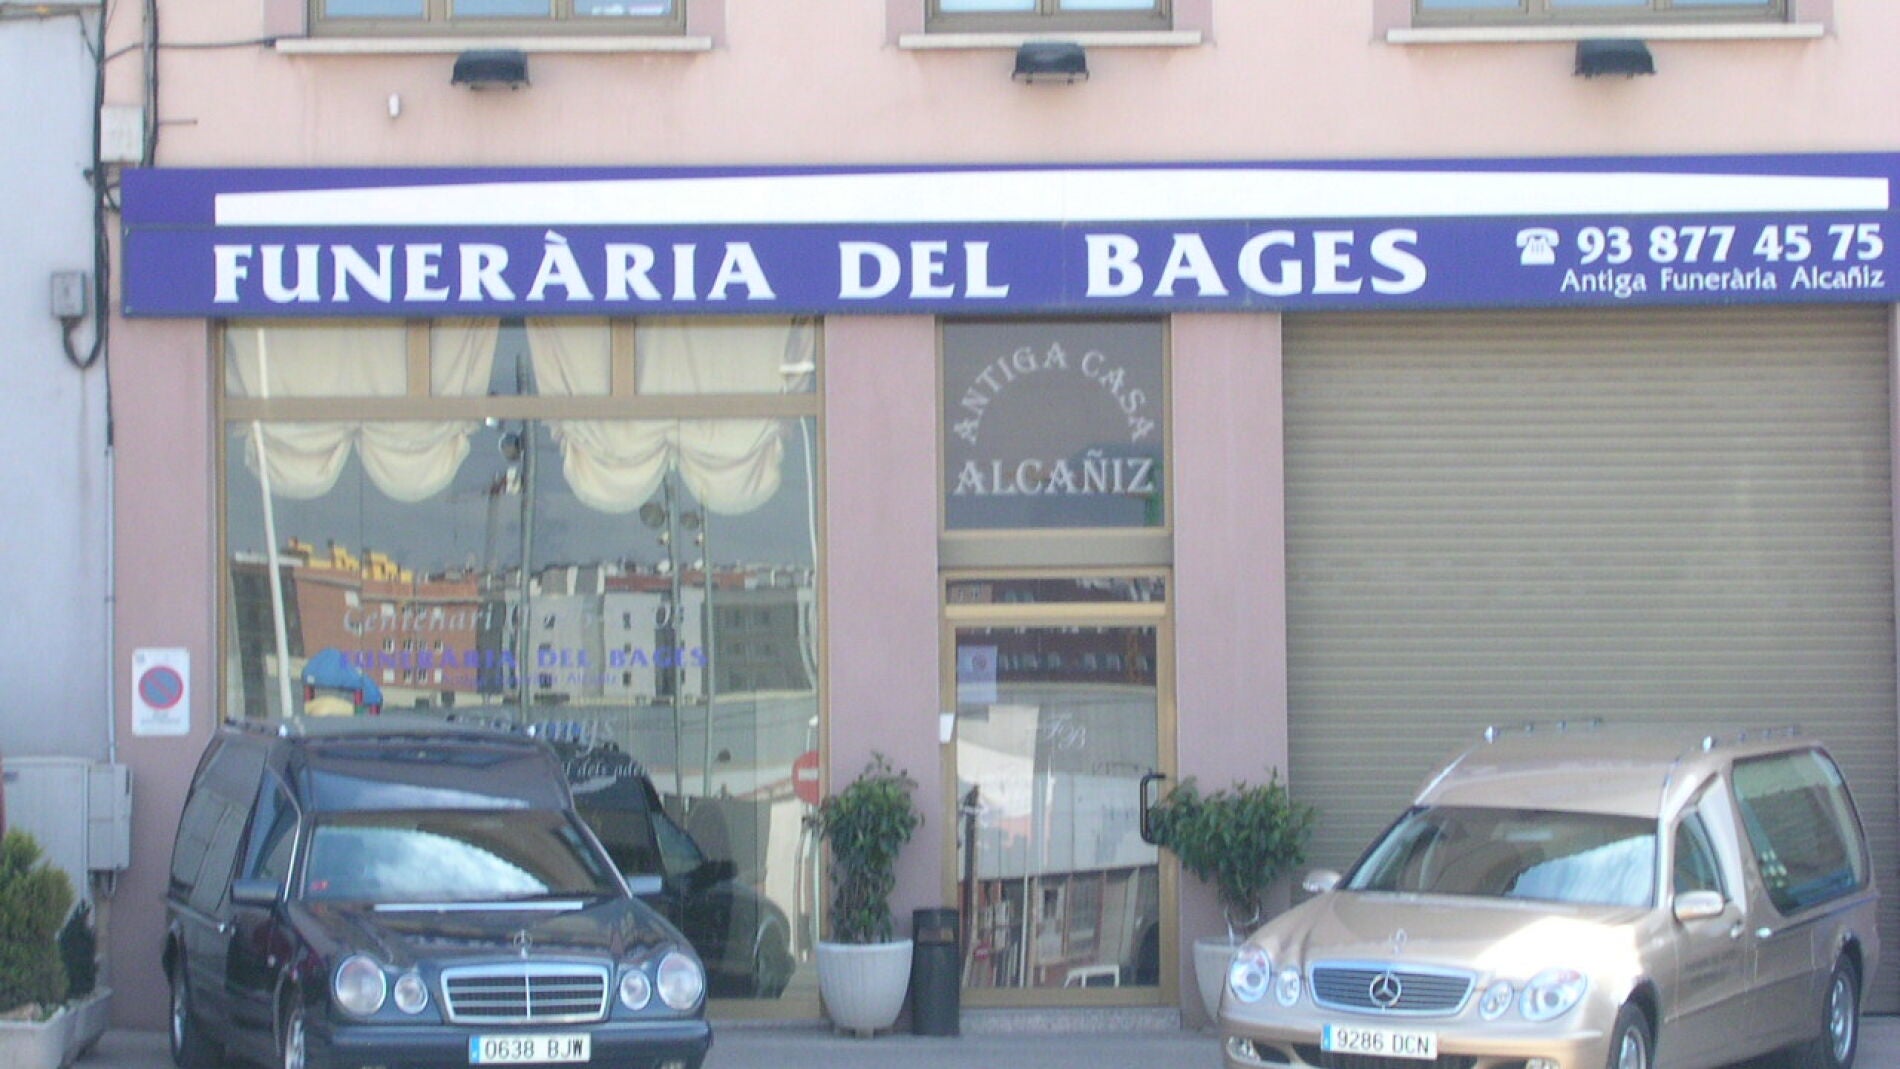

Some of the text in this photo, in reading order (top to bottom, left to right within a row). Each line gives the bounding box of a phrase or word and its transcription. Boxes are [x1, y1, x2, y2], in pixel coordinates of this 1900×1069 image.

[1576, 223, 1885, 265] 93 877 45 75
[213, 229, 1427, 303] FUNERÀRIA DEL BAGES
[1560, 265, 1886, 298] Antiga Funerària Alcañiz
[953, 341, 1155, 445] ANTIGA CASA
[953, 449, 1154, 495] ALCAÑIZ
[537, 648, 590, 668] DEL
[609, 647, 709, 668] BAGES
[485, 1038, 584, 1060] 0638 BJW
[1337, 1029, 1430, 1055] 9286 DCN
